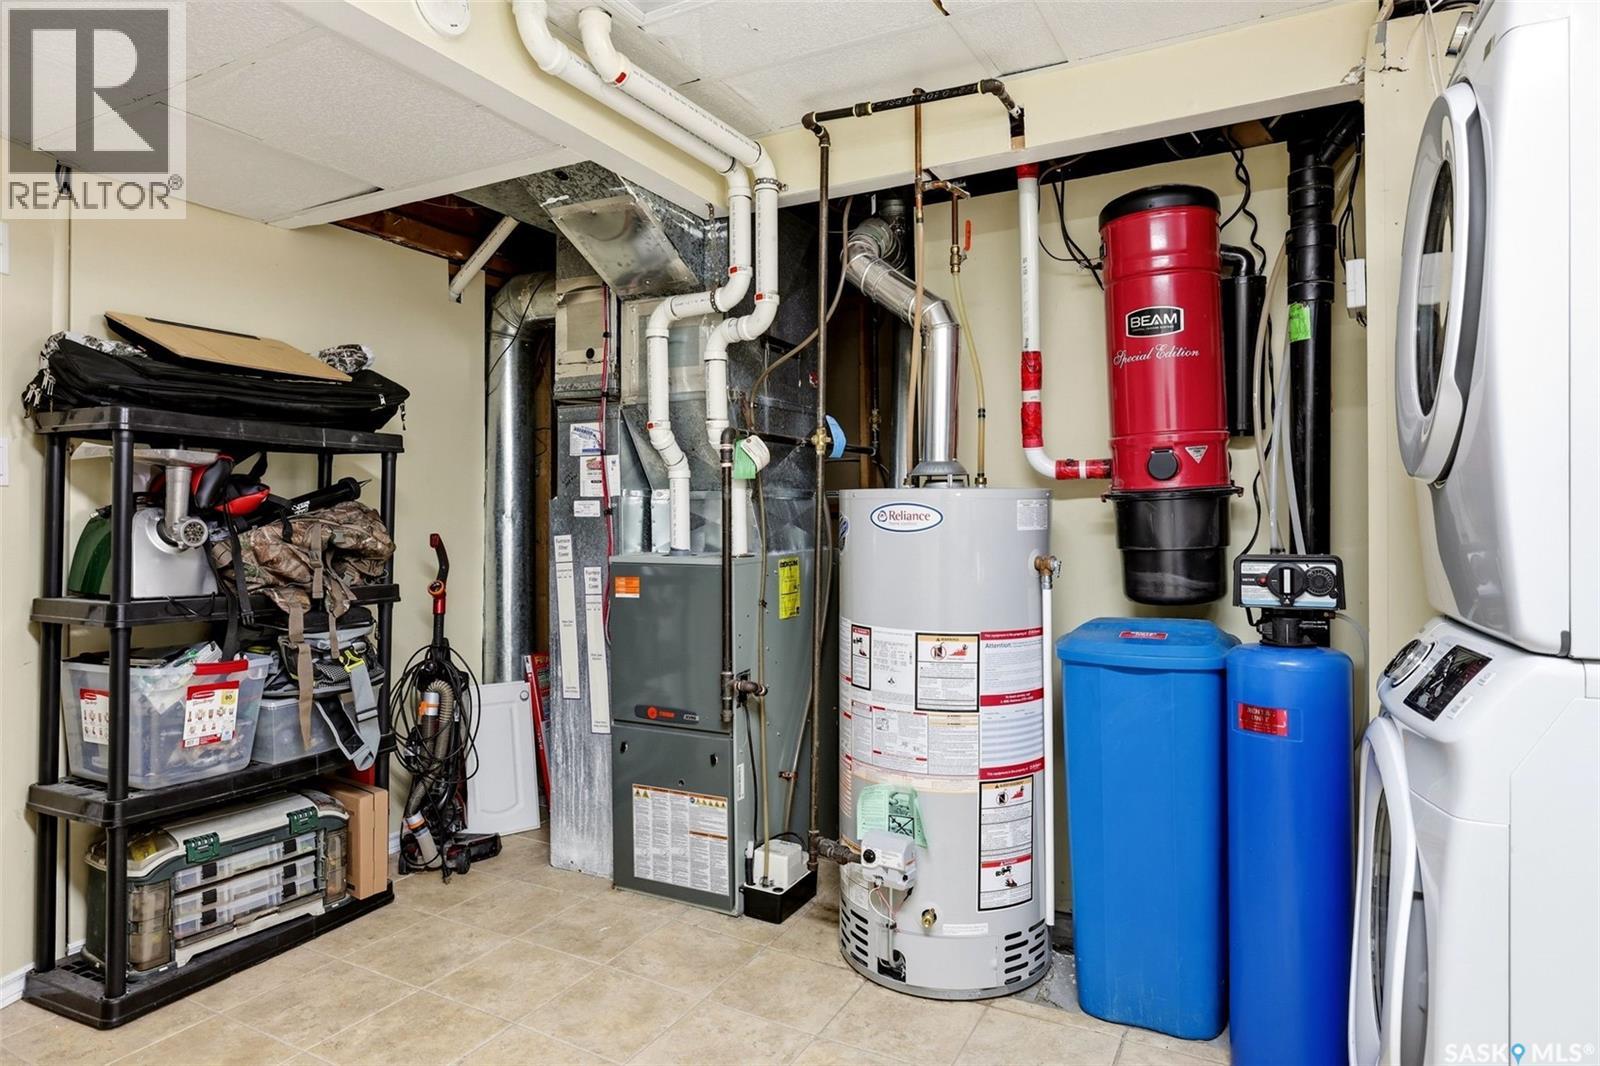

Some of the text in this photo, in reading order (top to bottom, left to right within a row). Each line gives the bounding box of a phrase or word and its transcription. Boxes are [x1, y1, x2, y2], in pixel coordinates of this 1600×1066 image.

[1130, 312, 1177, 328] BEAM
[1113, 344, 1200, 369] Special Edition
[889, 510, 931, 521] Reliance
